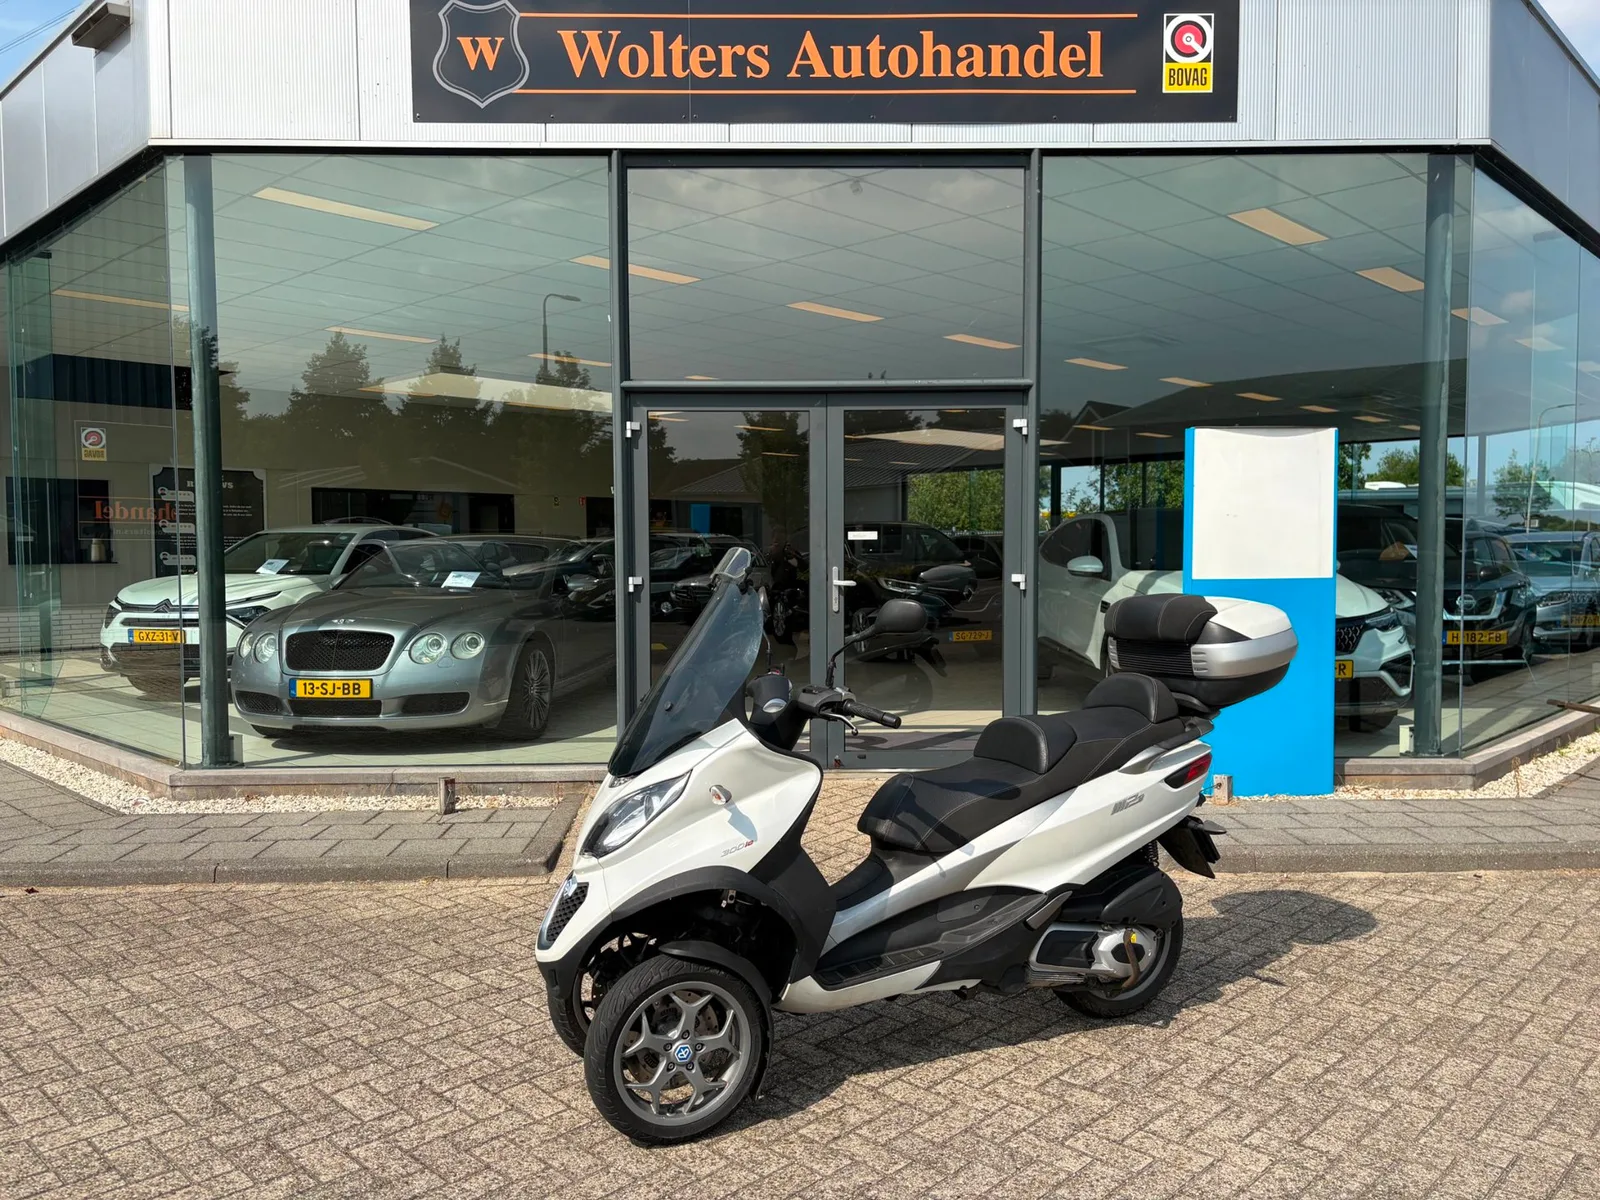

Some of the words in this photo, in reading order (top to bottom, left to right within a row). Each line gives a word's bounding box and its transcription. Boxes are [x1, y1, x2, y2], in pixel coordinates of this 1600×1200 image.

[456, 36, 505, 71] W
[557, 29, 770, 79] Wolters
[786, 29, 1104, 79] Autohandel
[1168, 68, 1208, 87] BOVAG
[138, 631, 179, 642] GXZ-31-V
[302, 682, 361, 696] 13-SJ-BB
